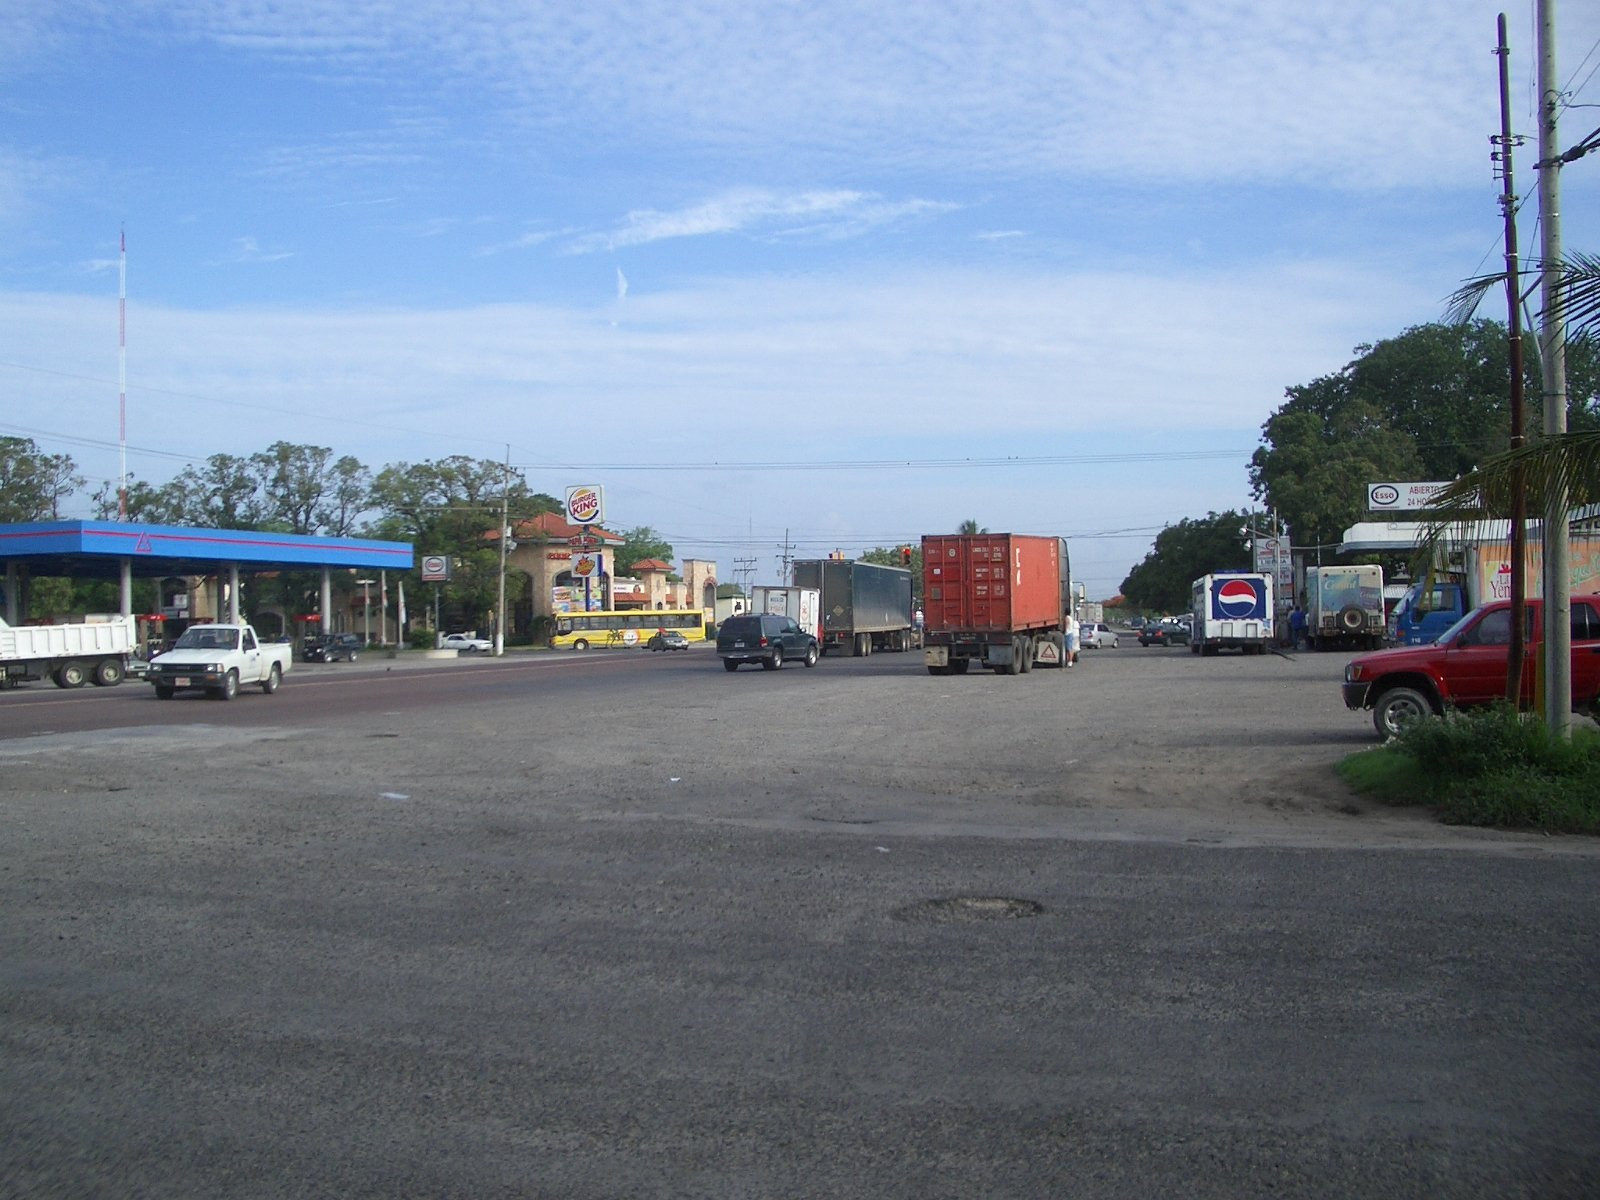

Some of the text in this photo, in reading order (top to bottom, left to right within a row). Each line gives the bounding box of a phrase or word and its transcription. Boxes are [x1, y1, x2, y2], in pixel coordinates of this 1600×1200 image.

[1409, 485, 1439, 494] ABIERTO
[571, 492, 596, 507] BURGER
[1374, 491, 1395, 499] Esso
[1407, 498, 1415, 506] 24
[572, 498, 598, 516] KING
